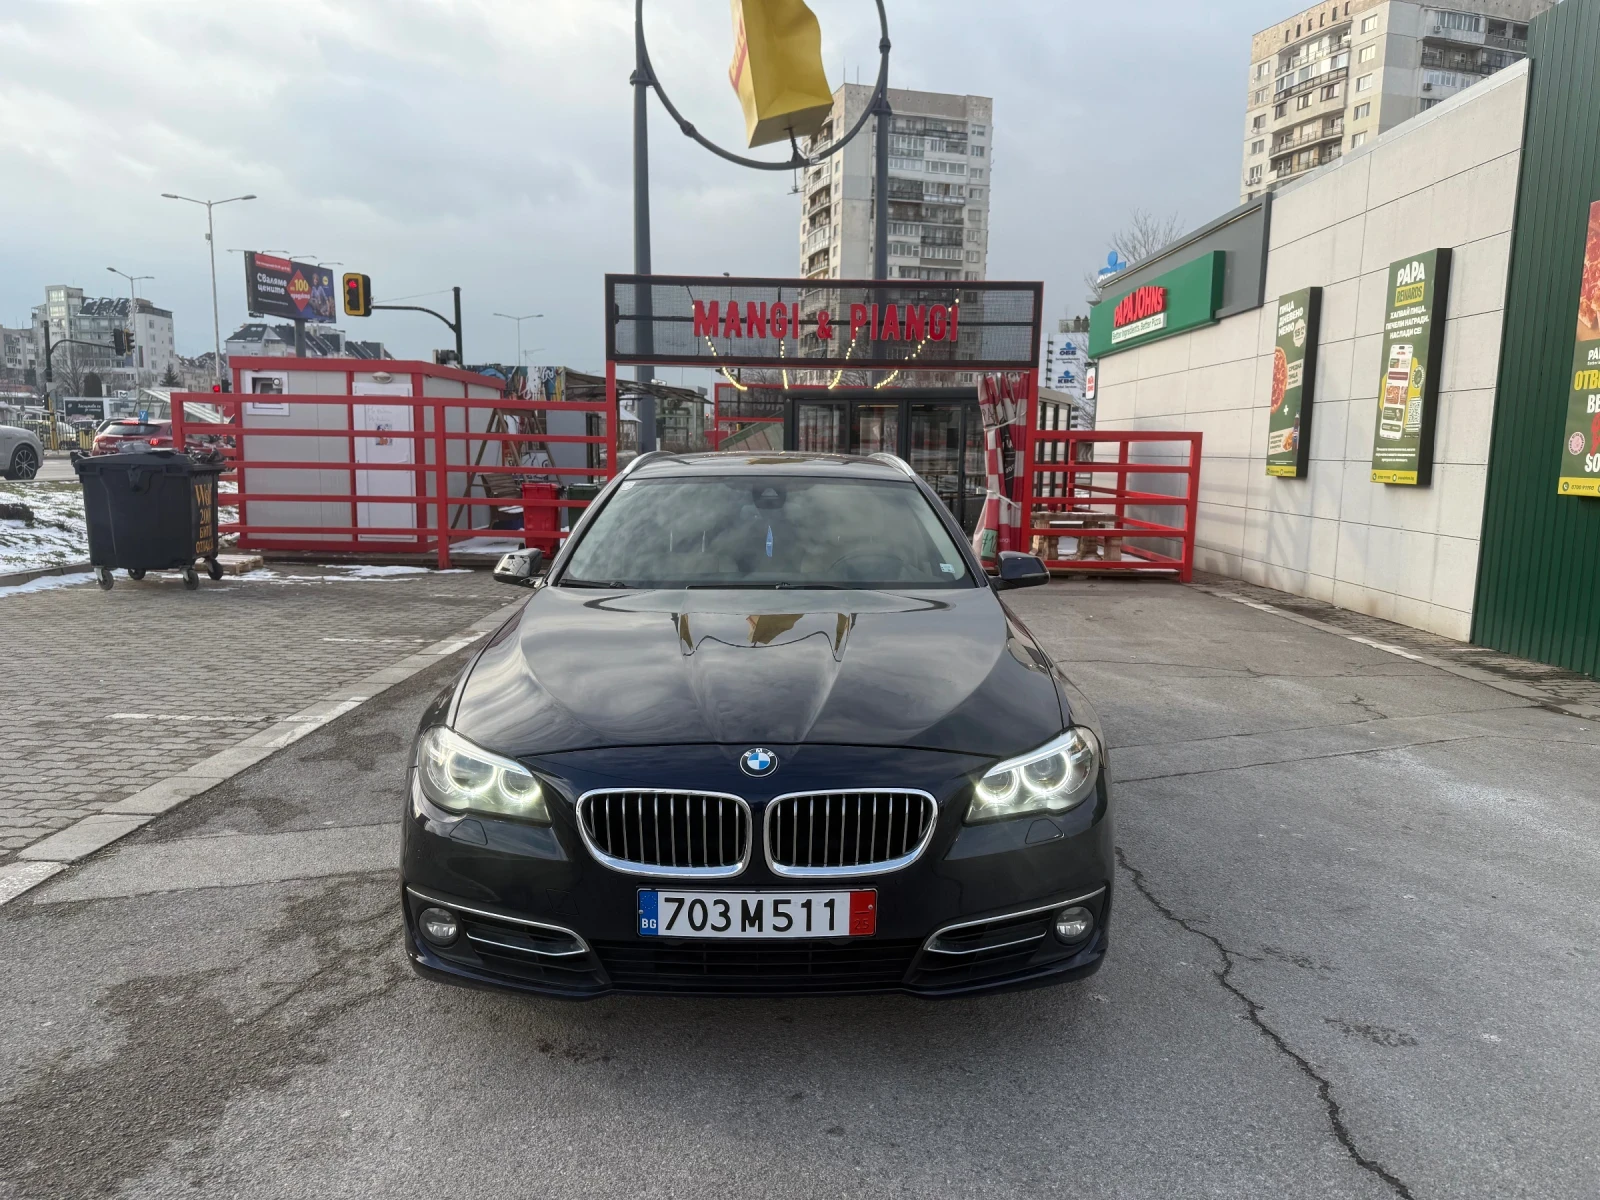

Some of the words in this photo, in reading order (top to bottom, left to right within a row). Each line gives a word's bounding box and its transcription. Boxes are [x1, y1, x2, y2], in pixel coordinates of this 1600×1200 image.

[257, 272, 288, 287] Сваляме
[1397, 261, 1425, 286] PAPA
[295, 279, 309, 292] 100
[1396, 286, 1423, 303] REWARDS
[1114, 292, 1134, 328] PAPA
[1133, 286, 1164, 321] JOHNS
[1279, 300, 1295, 315] ПИЦА
[694, 300, 799, 339] MANGI
[817, 310, 833, 340] &
[850, 303, 959, 342] PIANGI
[1588, 347, 1600, 360] PA
[744, 748, 774, 757] BMW
[641, 918, 657, 929] BG
